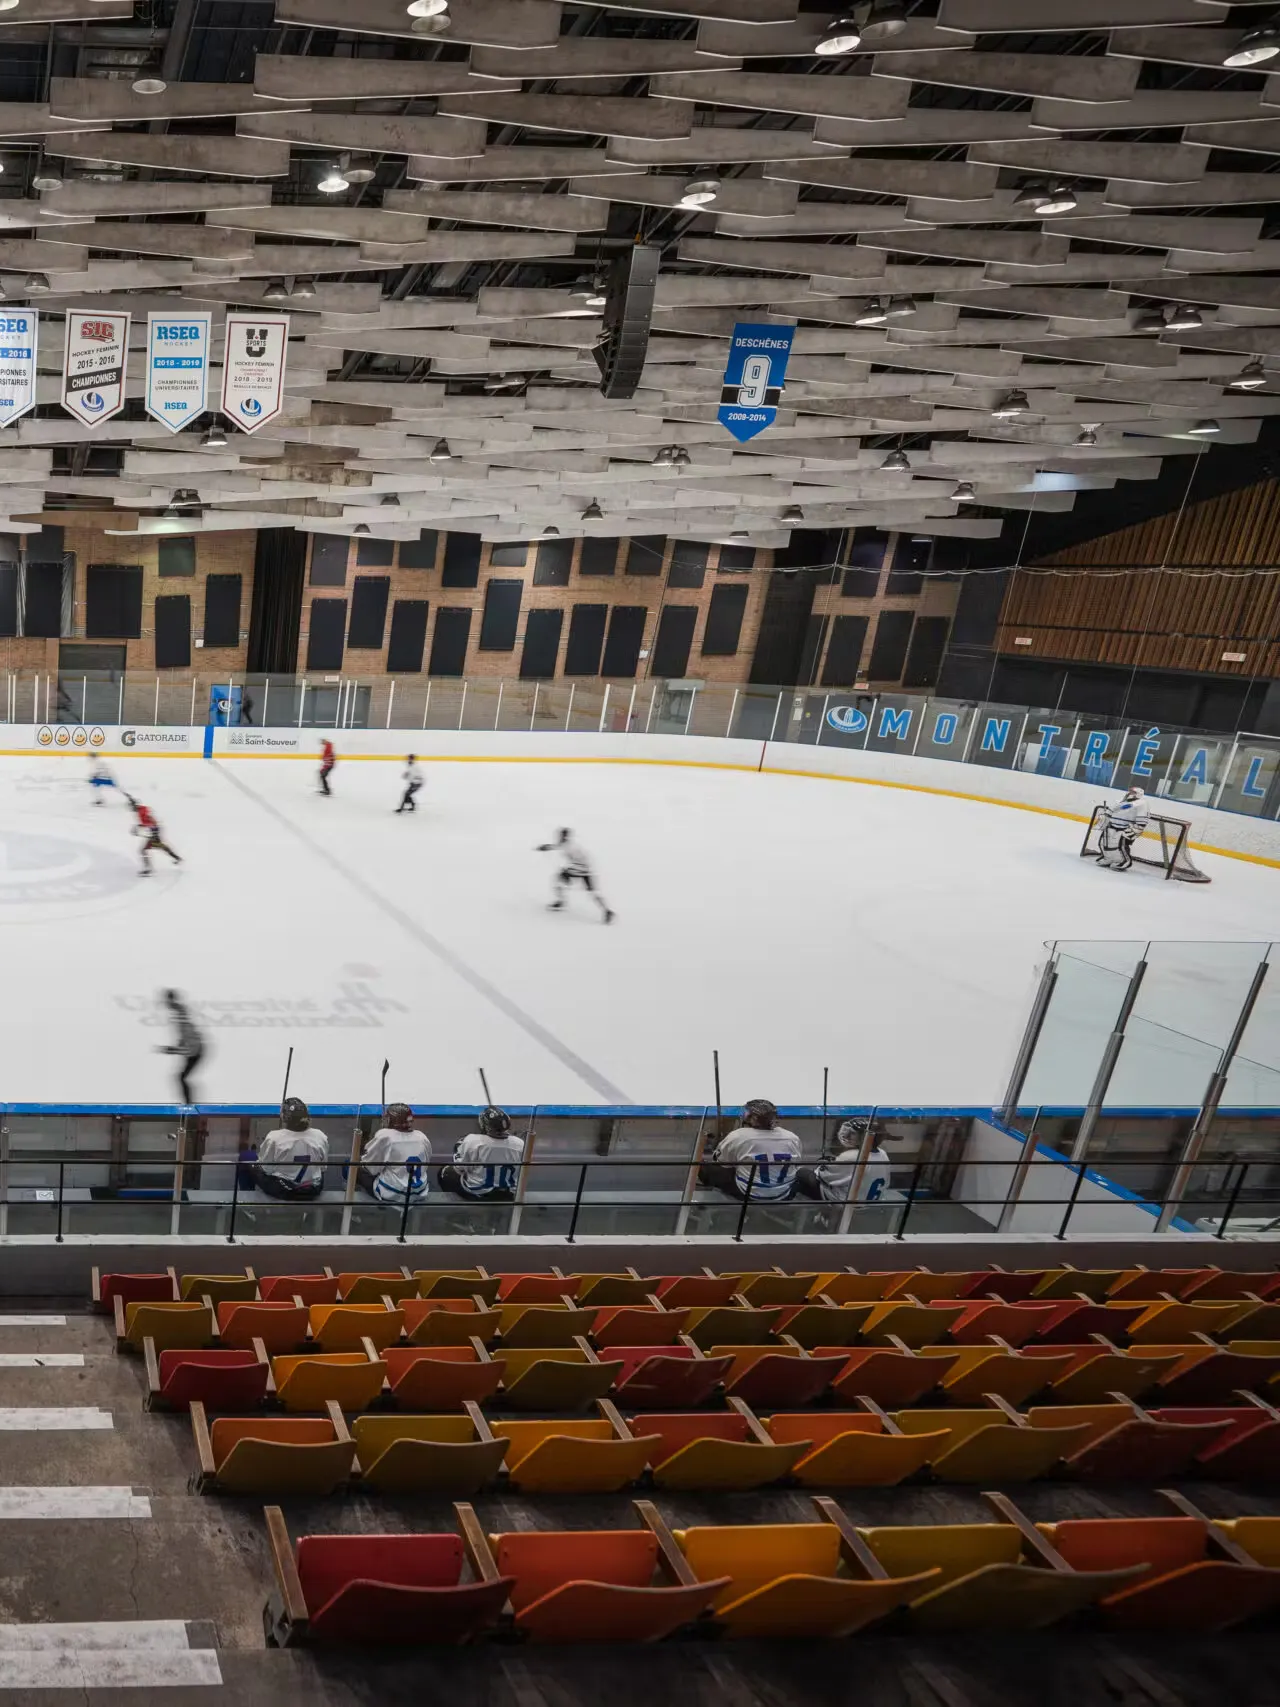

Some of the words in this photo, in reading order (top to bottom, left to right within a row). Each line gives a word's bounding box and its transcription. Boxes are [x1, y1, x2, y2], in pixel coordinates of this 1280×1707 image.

[80, 321, 115, 338] SIC
[156, 326, 200, 340] RSEQ
[735, 338, 789, 349] DESCHÊNES
[8, 349, 28, 357] 2016
[77, 358, 93, 369] 2015
[99, 355, 115, 365] 2016
[72, 372, 117, 389] CHAMPIONNES
[737, 354, 772, 409] 9
[164, 402, 188, 410] RSEQ
[137, 734, 187, 742] GATORADE
[245, 738, 297, 746] Saint-Sauveur
[877, 707, 1267, 798] MONTRÉAL
[293, 1155, 311, 1182] 7
[754, 1153, 793, 1184] 17
[866, 1178, 885, 1201] 6
